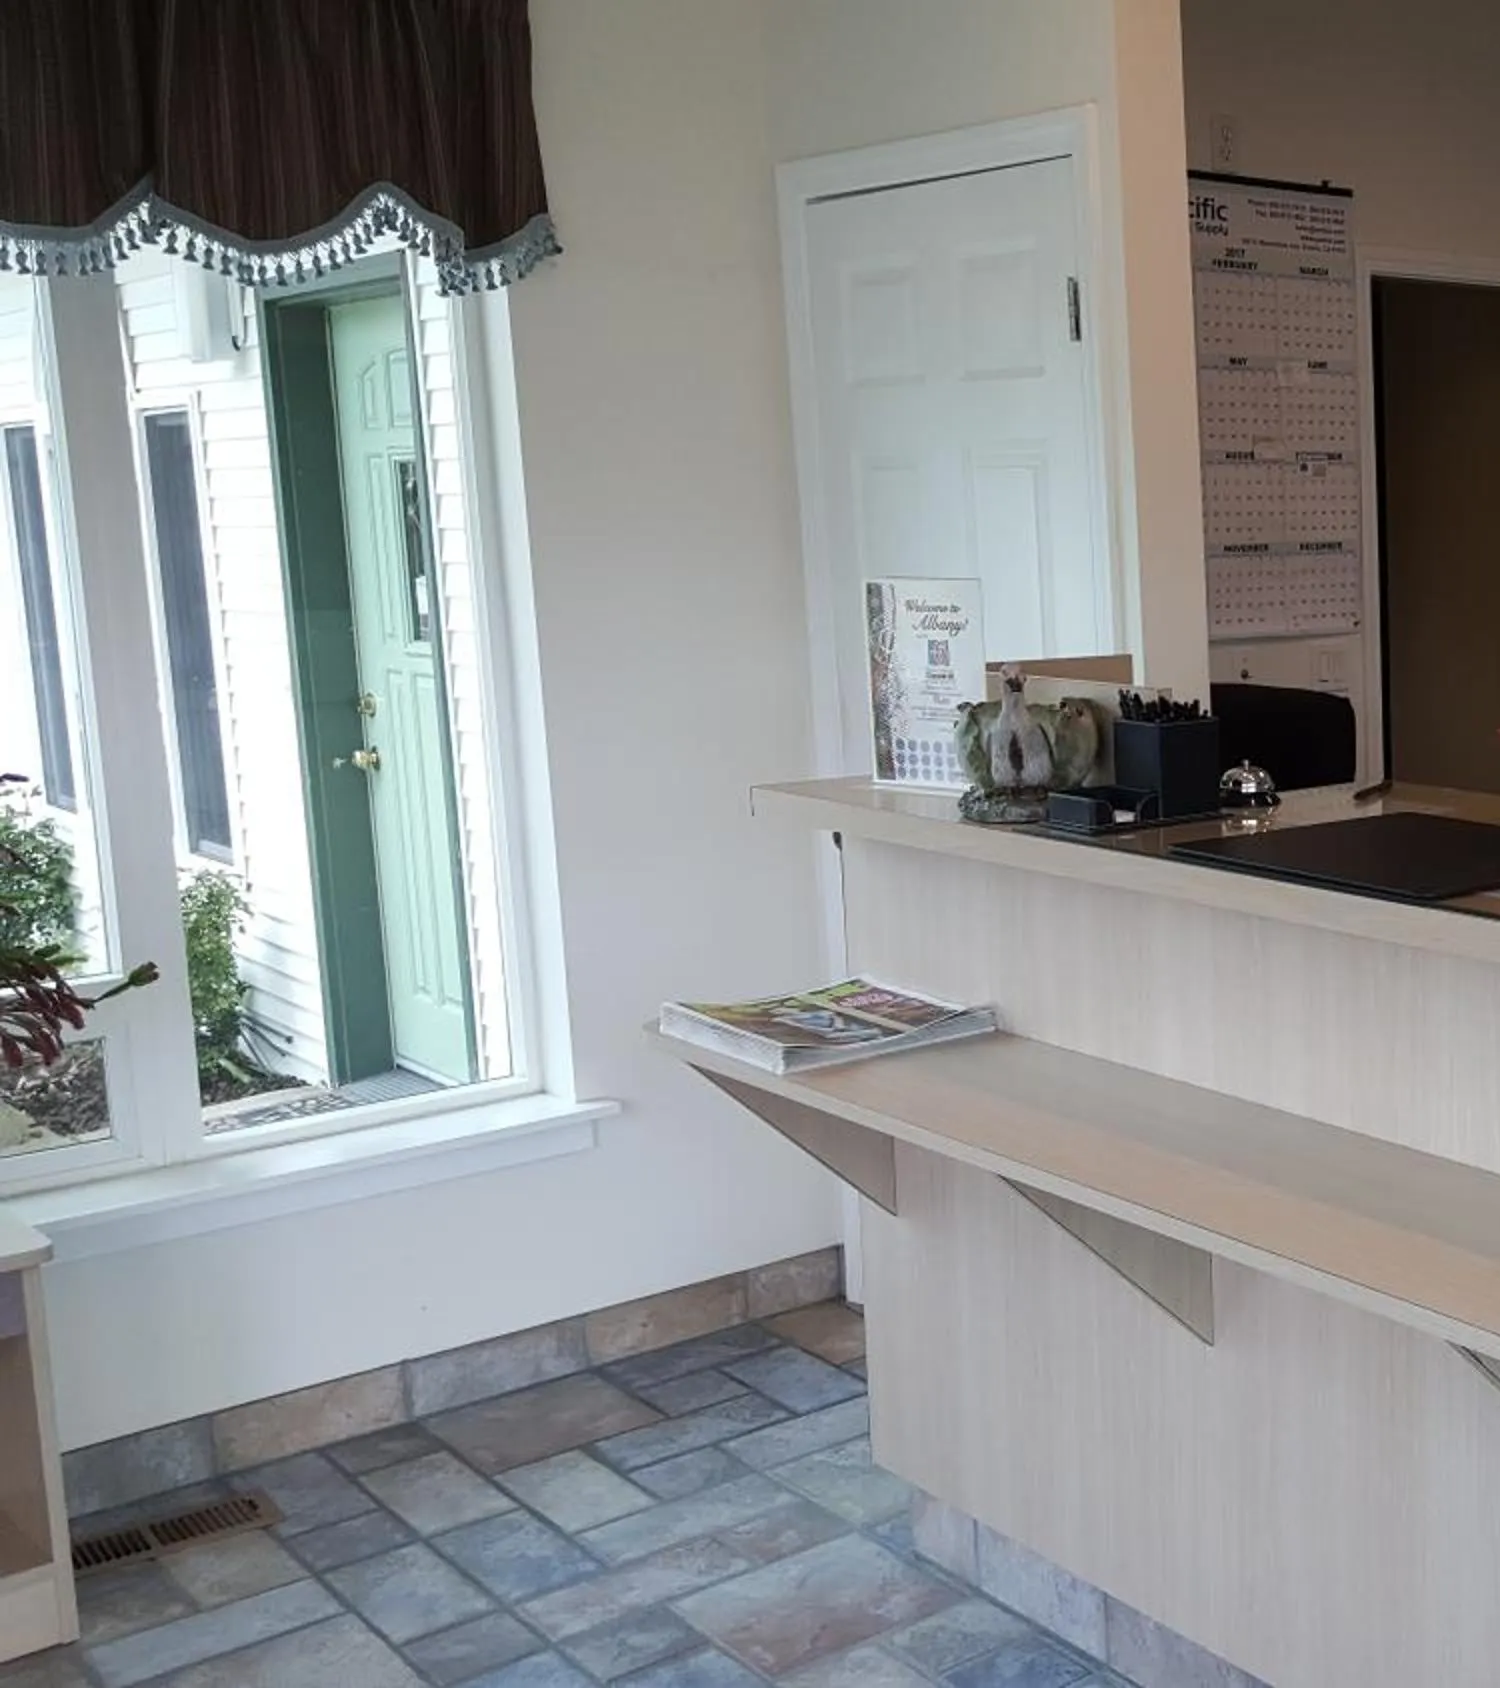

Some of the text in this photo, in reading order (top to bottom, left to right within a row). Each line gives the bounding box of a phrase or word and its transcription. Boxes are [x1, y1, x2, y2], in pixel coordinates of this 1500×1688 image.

[1189, 196, 1229, 221] ific
[1195, 222, 1229, 236] Supply
[905, 599, 961, 613] Welcome to
